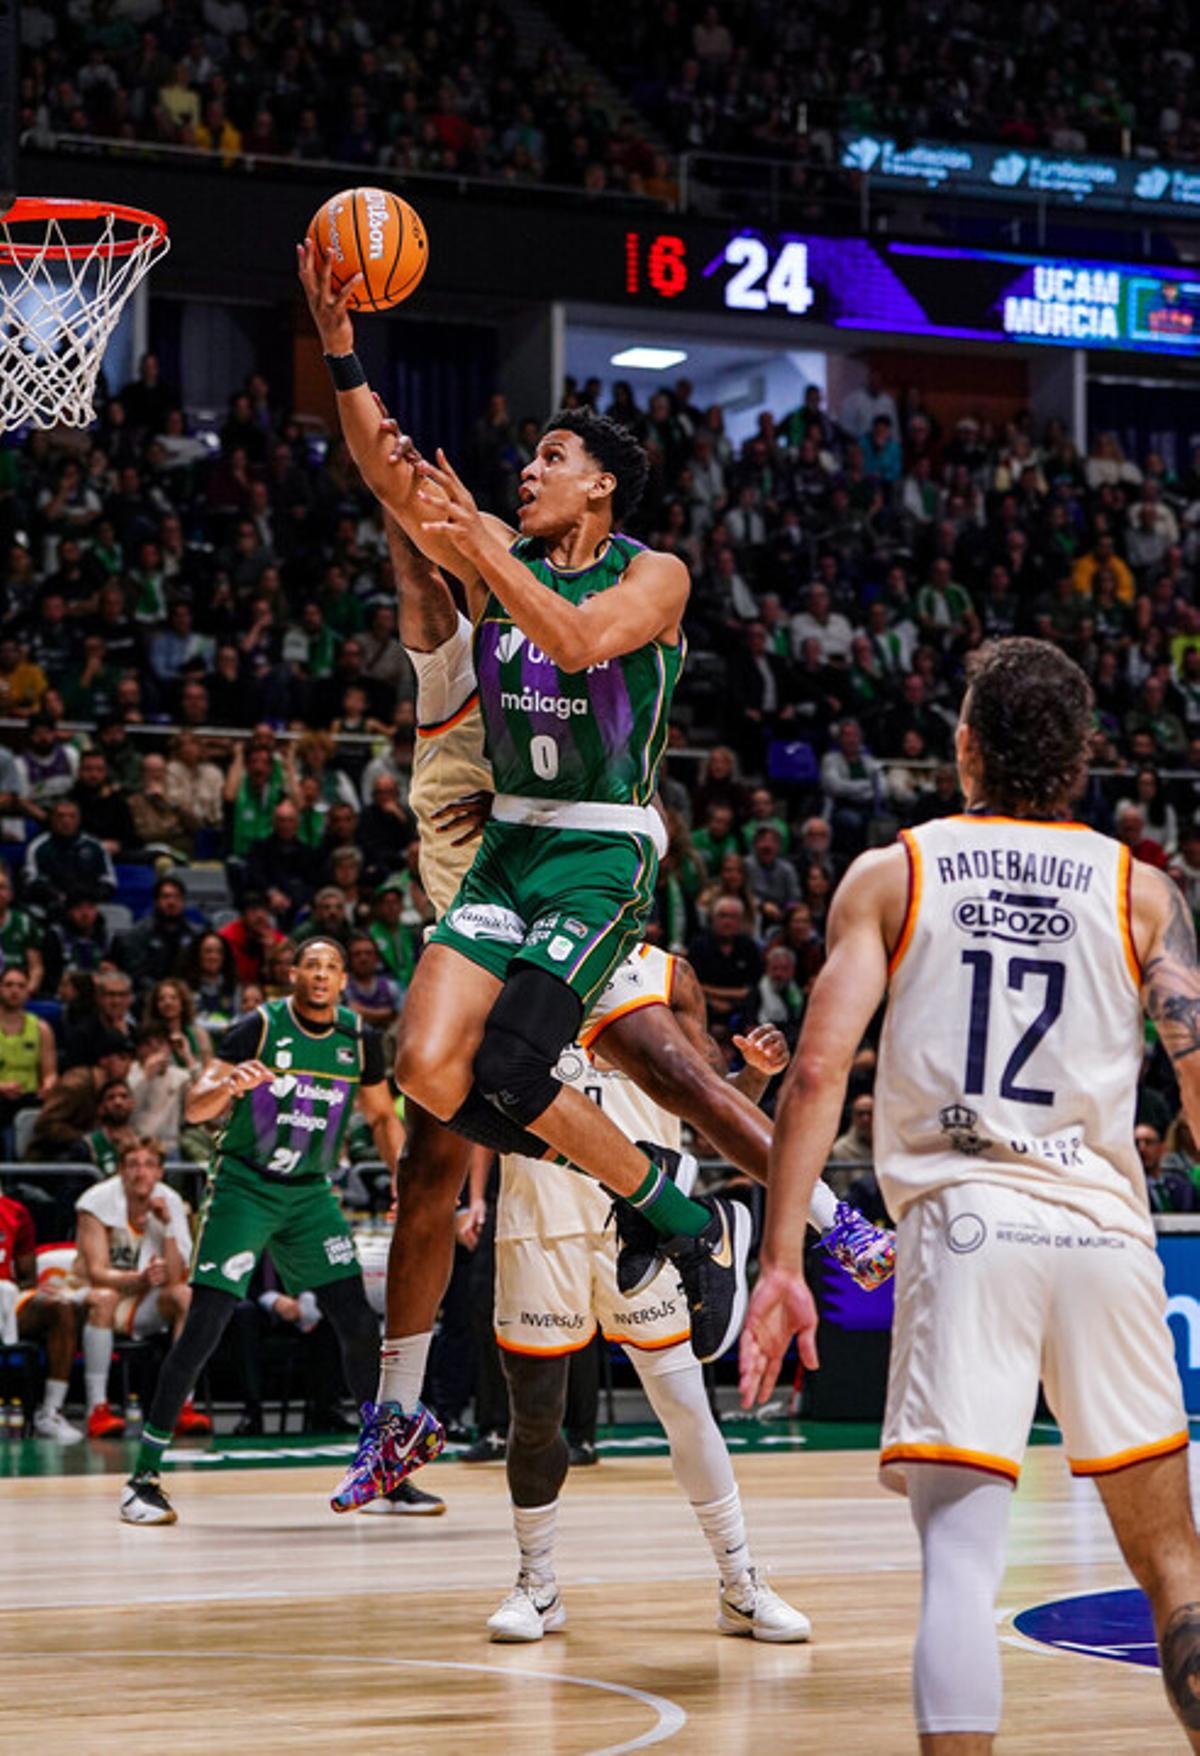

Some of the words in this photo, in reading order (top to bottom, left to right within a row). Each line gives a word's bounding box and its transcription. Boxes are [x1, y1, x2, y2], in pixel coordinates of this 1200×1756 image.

[364, 190, 390, 260] Wilson
[724, 236, 814, 314] 24
[1033, 265, 1119, 305] UCAM
[1003, 295, 1119, 340] MURCIA
[500, 685, 588, 720] málaga
[530, 735, 558, 780] 0
[937, 849, 1093, 893] RADEBAUGH
[961, 949, 1066, 1106] 12
[1055, 1235, 1073, 1248] DE
